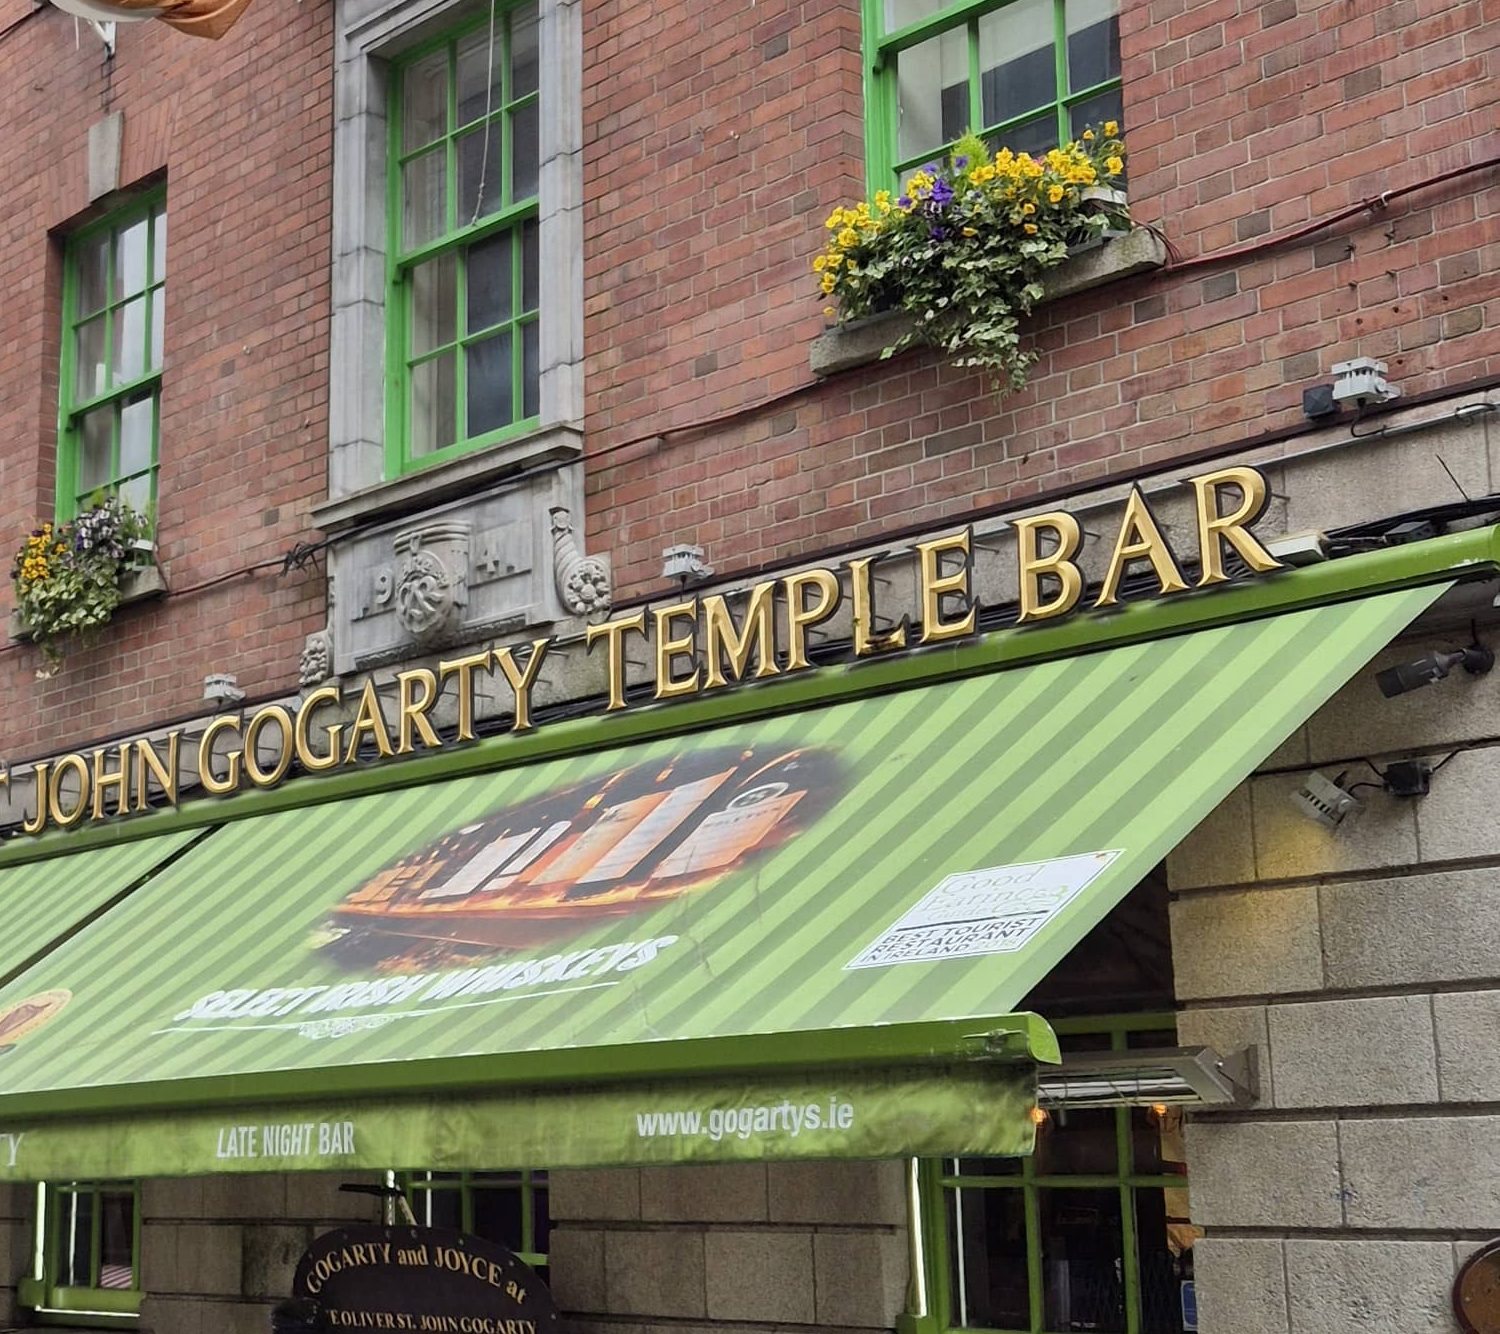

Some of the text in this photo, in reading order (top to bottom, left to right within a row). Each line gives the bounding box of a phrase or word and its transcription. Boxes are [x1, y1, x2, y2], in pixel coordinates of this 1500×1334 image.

[23, 731, 184, 834] JOHN
[199, 638, 550, 795] GOGARTY
[587, 524, 977, 711] TEMPLE
[1015, 464, 1283, 623] BAR
[871, 927, 1032, 954] RESTAURANT
[882, 917, 1043, 944] BEST TOURIST
[883, 943, 970, 959] IRELAND
[173, 934, 680, 1021] SELECT IRISH WHISKEYS
[215, 1121, 356, 1158] LATE NIGHT BAR
[636, 1099, 855, 1143] www.gogartys.ie
[306, 1243, 529, 1305] GOGARTY and JOYCE at
[340, 1310, 393, 1329] OLIVER
[397, 1313, 417, 1330] ST.
[419, 1315, 459, 1332] JOHN
